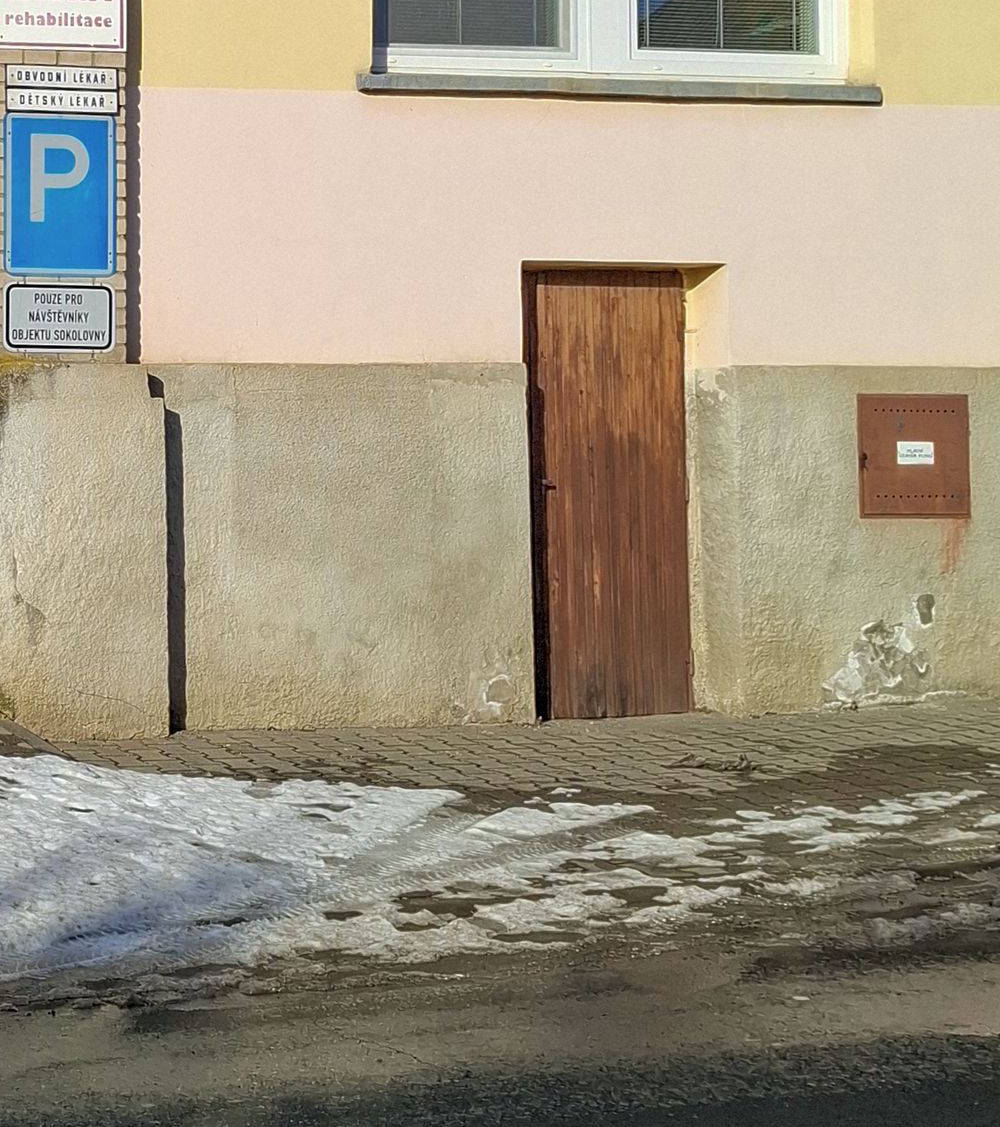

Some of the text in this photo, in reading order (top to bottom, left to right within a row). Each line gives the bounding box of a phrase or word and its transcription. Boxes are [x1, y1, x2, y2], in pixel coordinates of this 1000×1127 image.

[5, 12, 112, 27] rehabilitace
[17, 70, 106, 84] OBVODNÍ LÉKAŘ
[19, 93, 105, 108] DĚTSKÝ LÉKAŘ
[30, 133, 90, 222] P
[34, 293, 83, 305] POUZE PRO
[28, 309, 89, 323] NÁVŠTĚVNÍKY
[12, 329, 106, 341] OBJEKTU SOKOLOVNY
